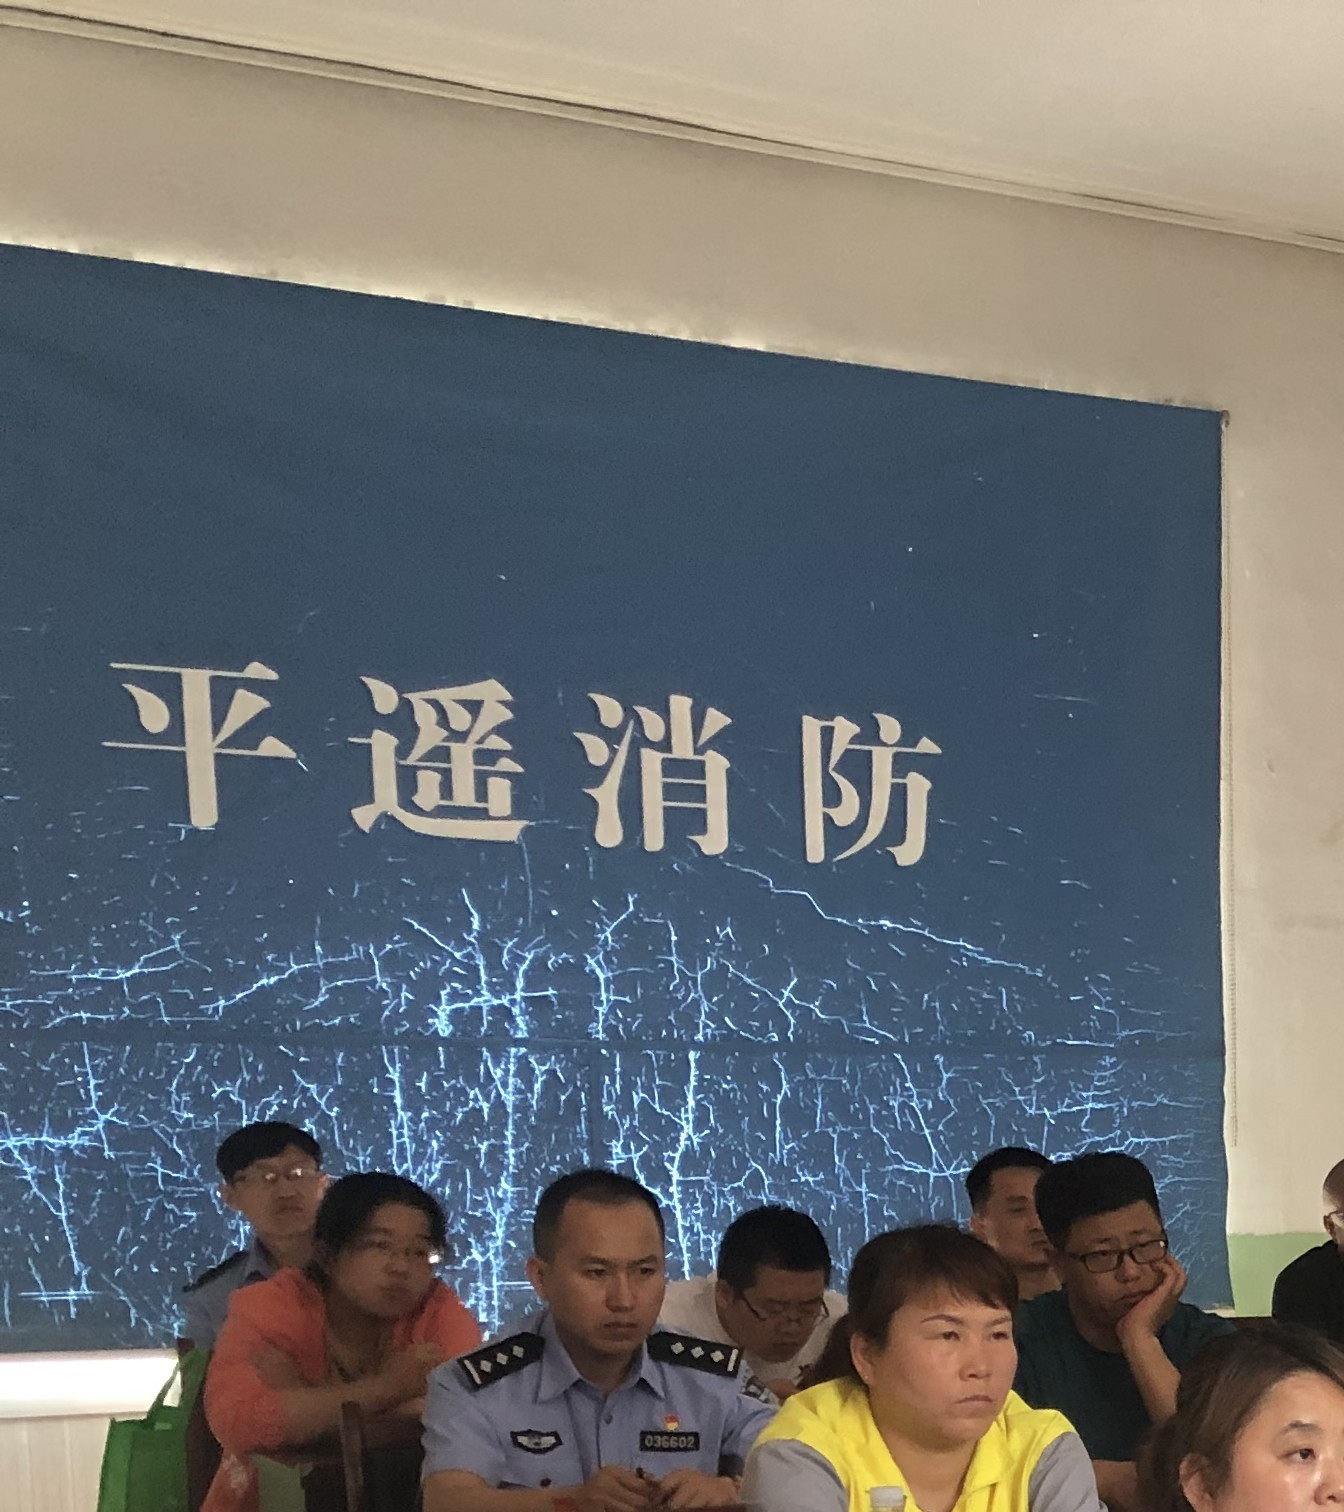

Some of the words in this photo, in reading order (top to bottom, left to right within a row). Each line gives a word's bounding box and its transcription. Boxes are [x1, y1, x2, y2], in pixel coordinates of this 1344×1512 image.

[102, 661, 943, 868] 平遥消防
[644, 1434, 696, 1449] 036602
